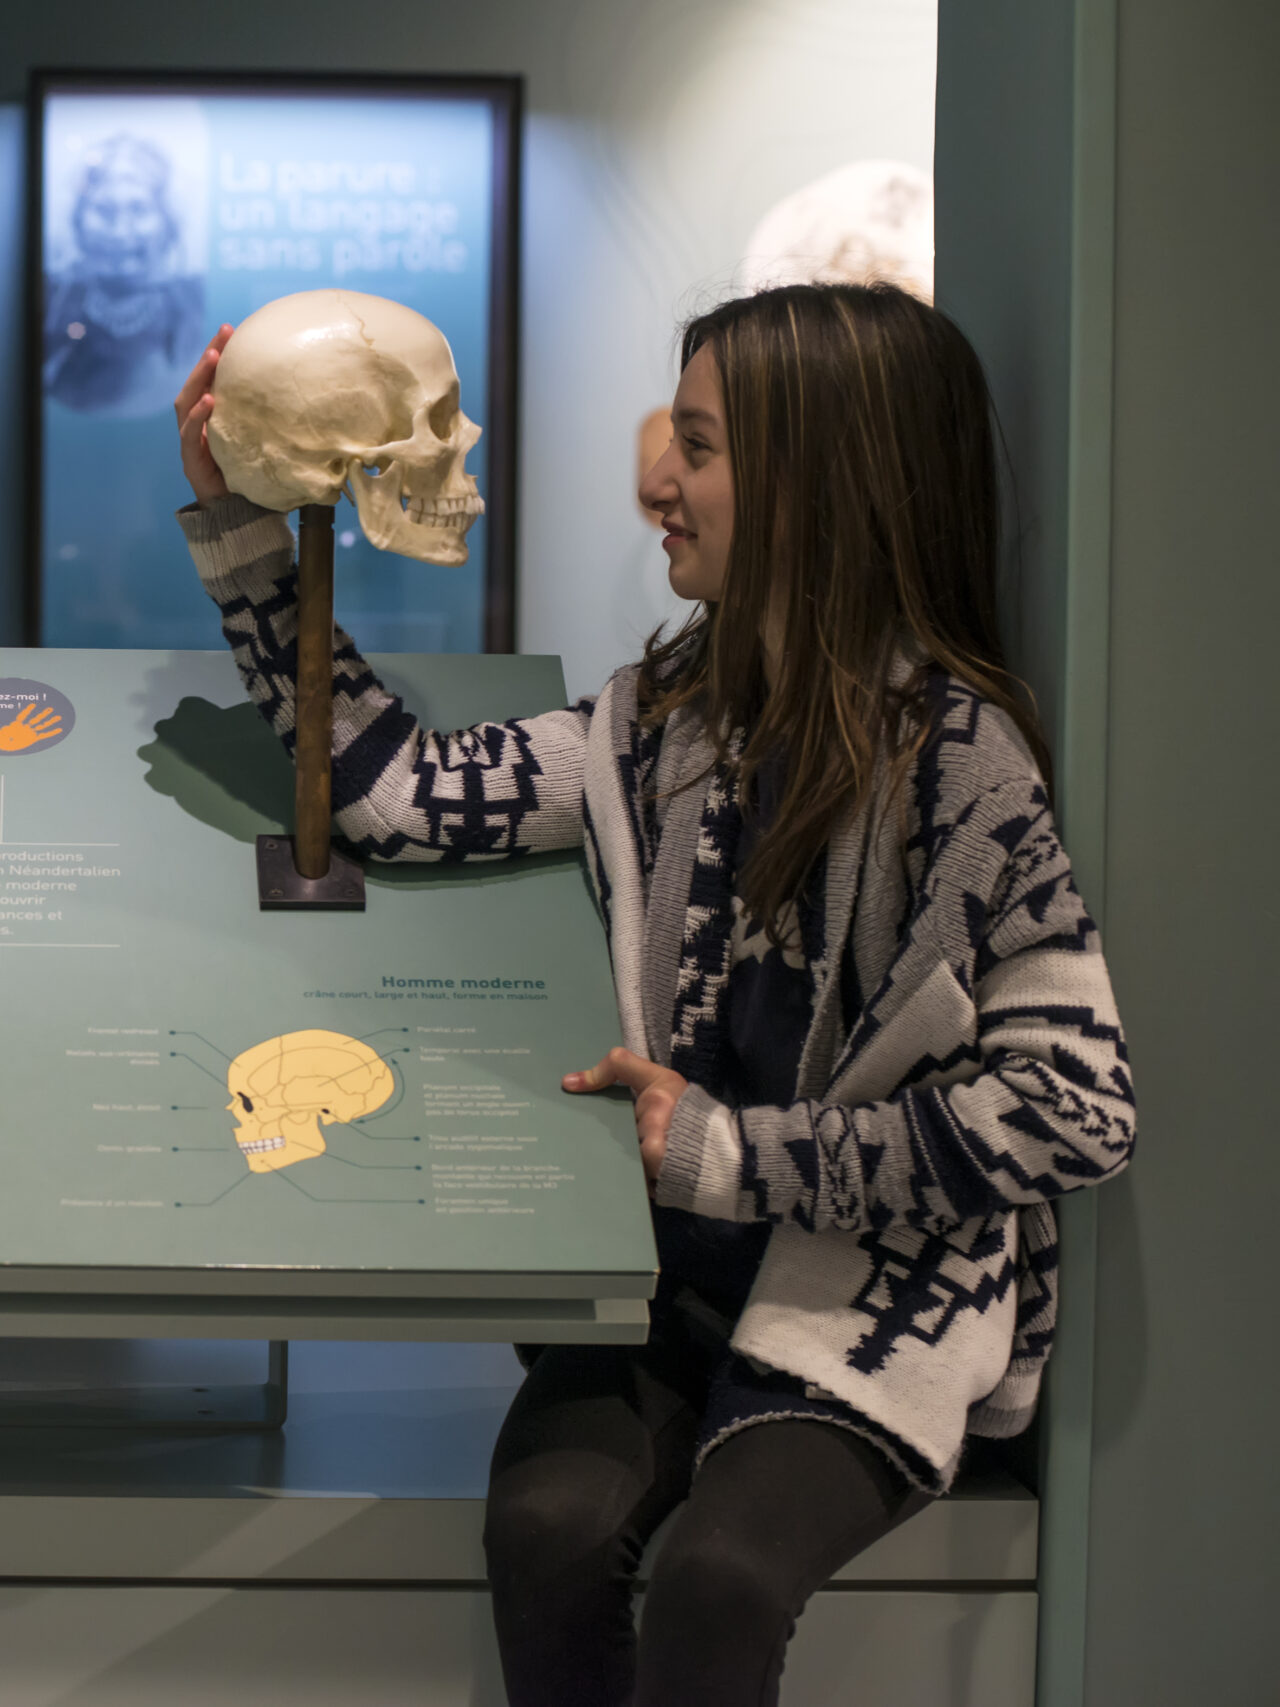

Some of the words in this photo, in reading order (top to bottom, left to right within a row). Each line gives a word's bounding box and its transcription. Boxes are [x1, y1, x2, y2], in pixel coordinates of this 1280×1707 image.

[220, 152, 272, 193] La
[276, 161, 417, 201] parure
[219, 199, 276, 231] un
[289, 192, 458, 242] langage
[219, 238, 322, 271] sans
[332, 232, 468, 279] parole
[9, 864, 121, 877] Néandertalien
[6, 881, 77, 892] moderne
[47, 910, 63, 920] et
[382, 976, 455, 989] Homme
[460, 976, 546, 990] moderne
